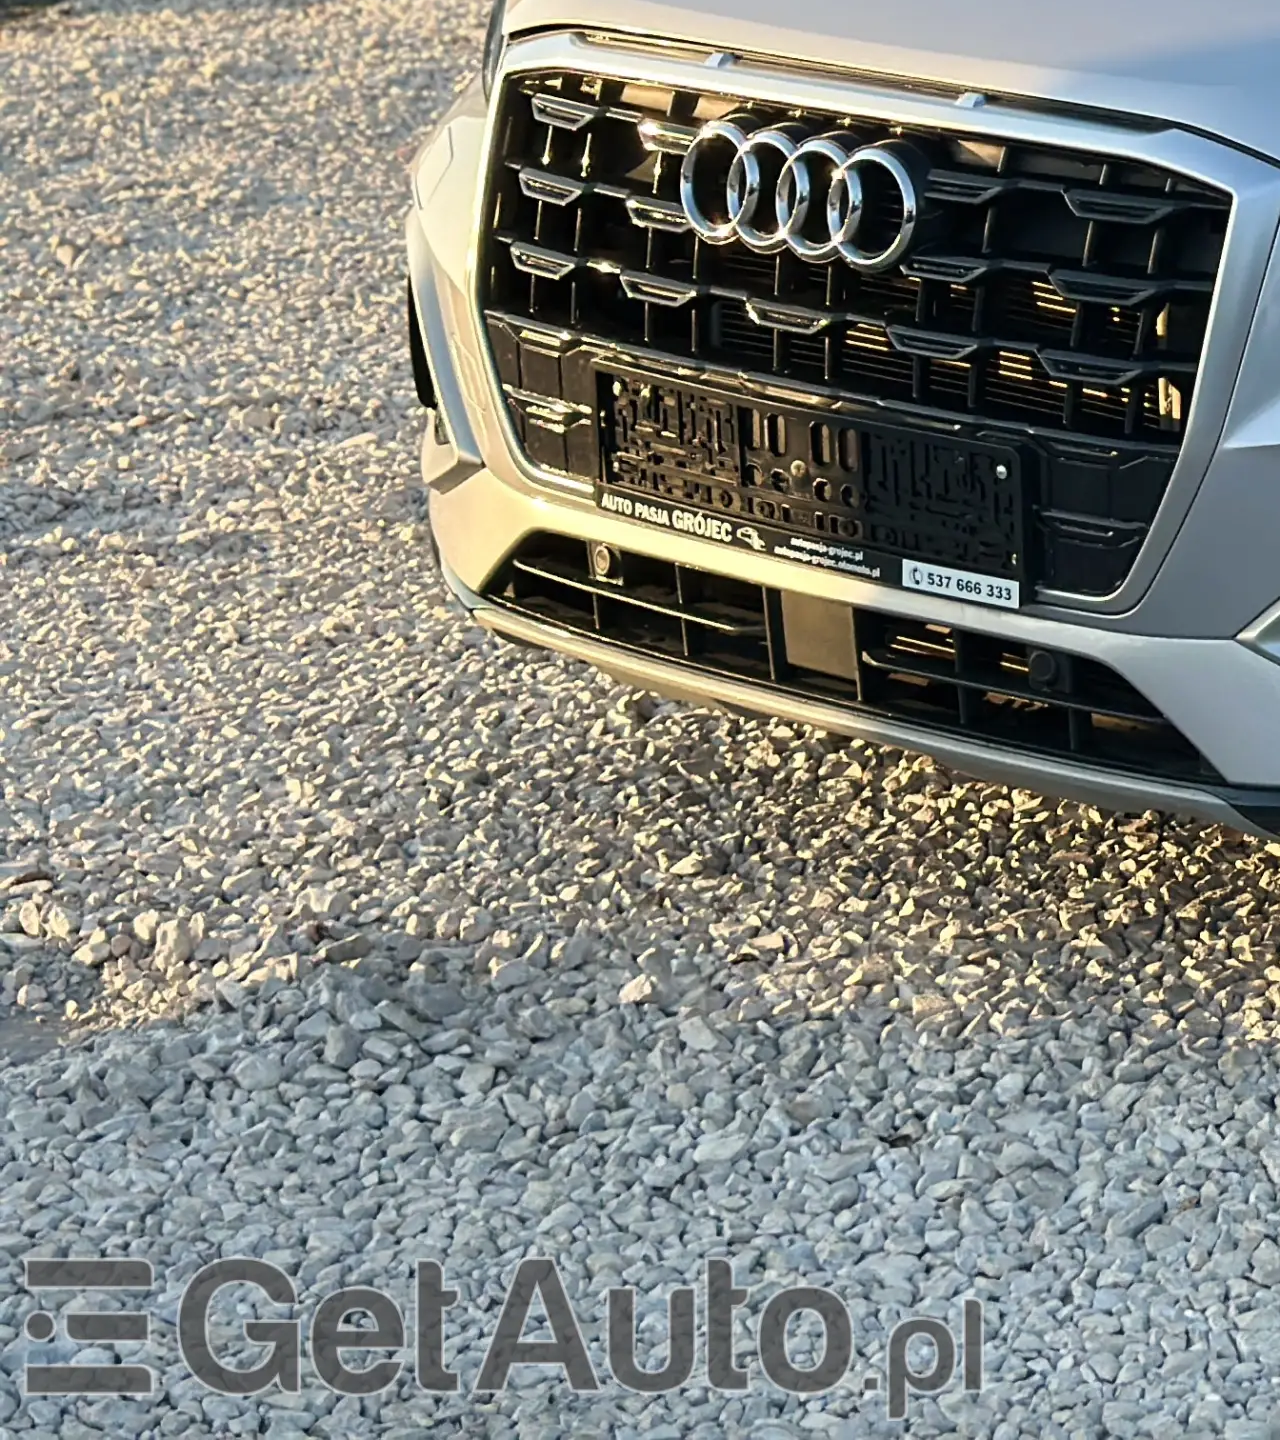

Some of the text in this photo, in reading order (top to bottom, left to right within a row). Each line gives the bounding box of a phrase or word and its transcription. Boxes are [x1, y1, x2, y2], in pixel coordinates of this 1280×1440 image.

[601, 492, 733, 543] AUTO PASJA GRÓJEC
[927, 572, 1012, 601] 537 666 333
